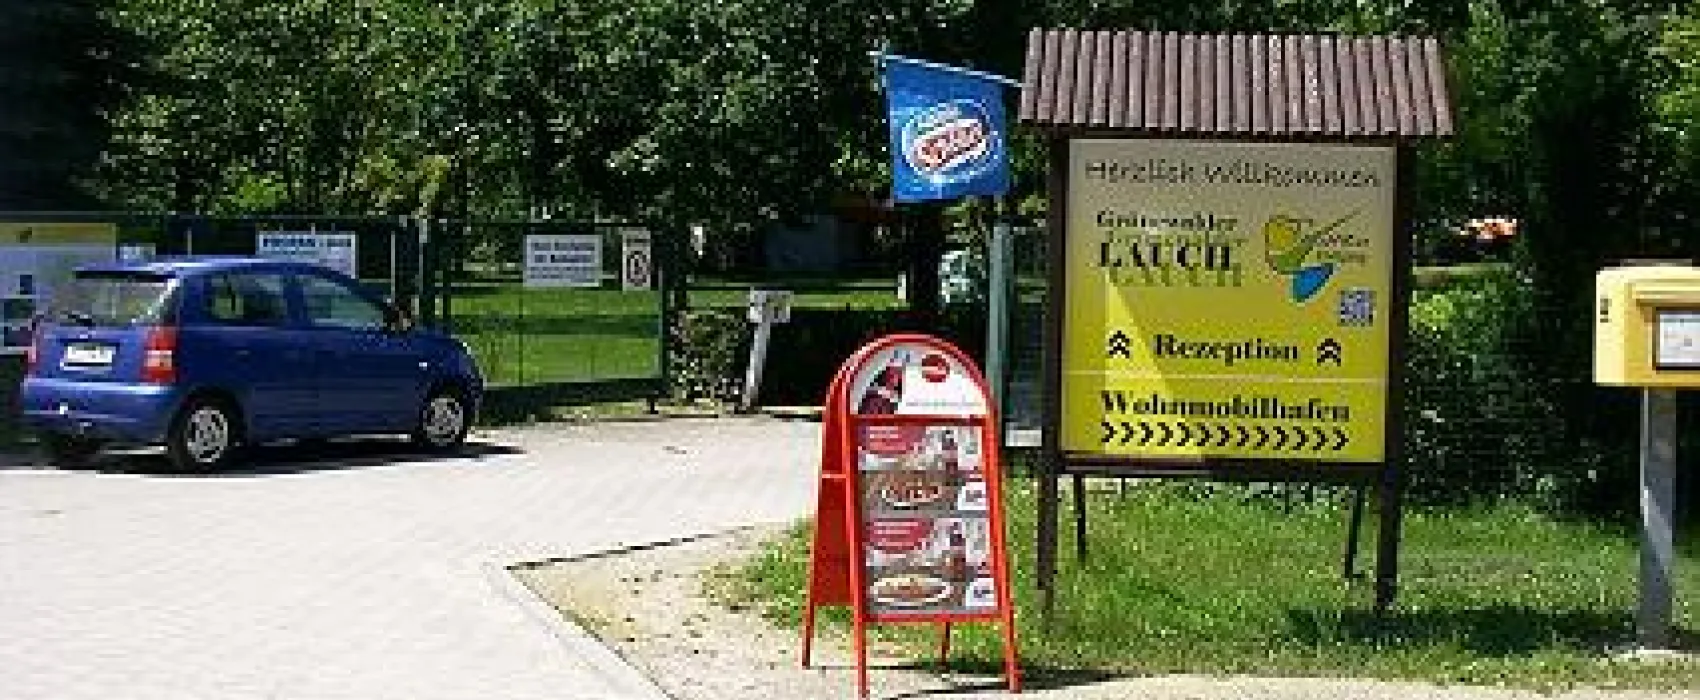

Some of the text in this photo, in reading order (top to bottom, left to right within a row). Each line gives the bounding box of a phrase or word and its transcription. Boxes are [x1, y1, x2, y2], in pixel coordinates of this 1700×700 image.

[1203, 159, 1382, 188] Willkommen
[1153, 333, 1299, 367] Rezeption
[1100, 389, 1350, 422] Wohnmobilhafen
